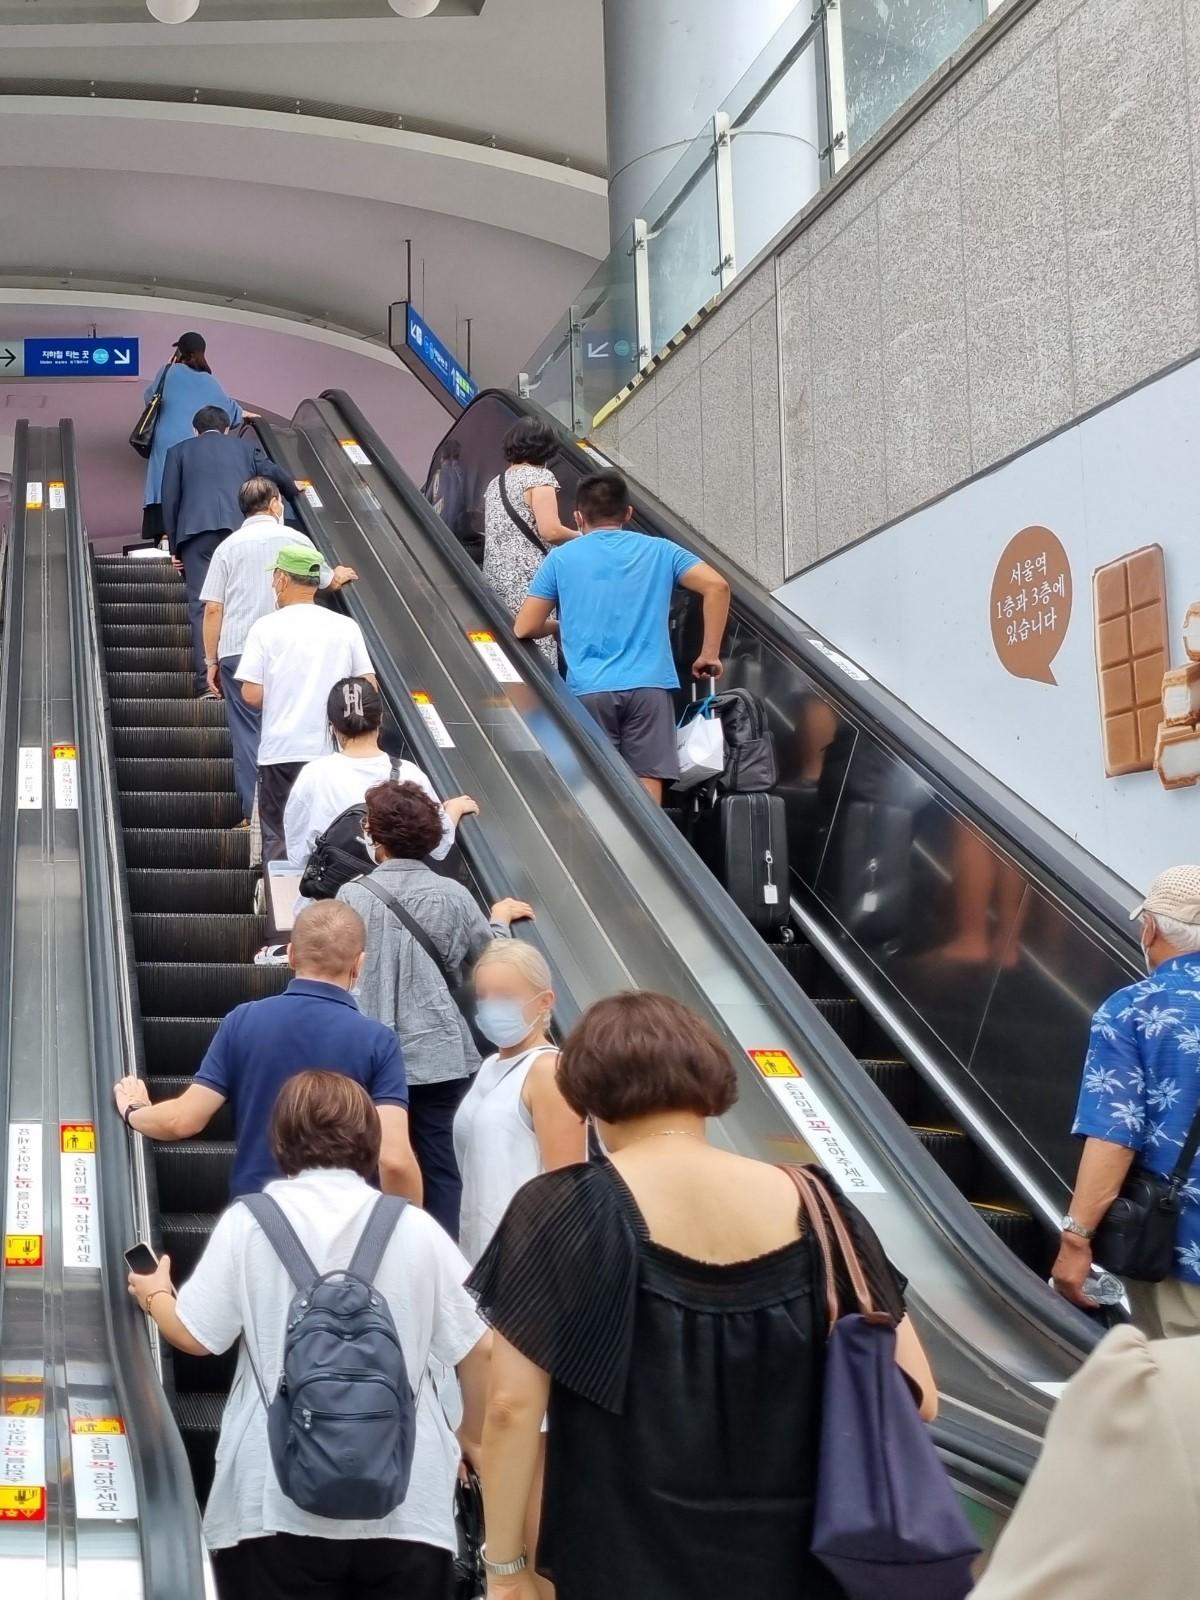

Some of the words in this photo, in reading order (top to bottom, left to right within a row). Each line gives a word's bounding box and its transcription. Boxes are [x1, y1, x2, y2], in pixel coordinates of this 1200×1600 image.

[42, 350, 63, 359] 지하철
[66, 350, 80, 359] 타는
[82, 350, 89, 359] 곳
[1010, 552, 1047, 586] 서울역
[996, 588, 1028, 619] 1층과
[1031, 574, 1064, 606] 3층에
[1006, 606, 1058, 646] 있습니다
[784, 1082, 818, 1118] 손잡이를
[807, 1120, 832, 1134] 꼭
[821, 1136, 870, 1187] 잡아주세요
[14, 1176, 32, 1188] 꼭
[74, 1158, 87, 1194] 손잡이를
[72, 1197, 91, 1210] 꼭
[75, 1214, 92, 1262] 잡아주세요
[87, 1461, 120, 1471] 꼭
[92, 1472, 120, 1512] 잡아주세요
